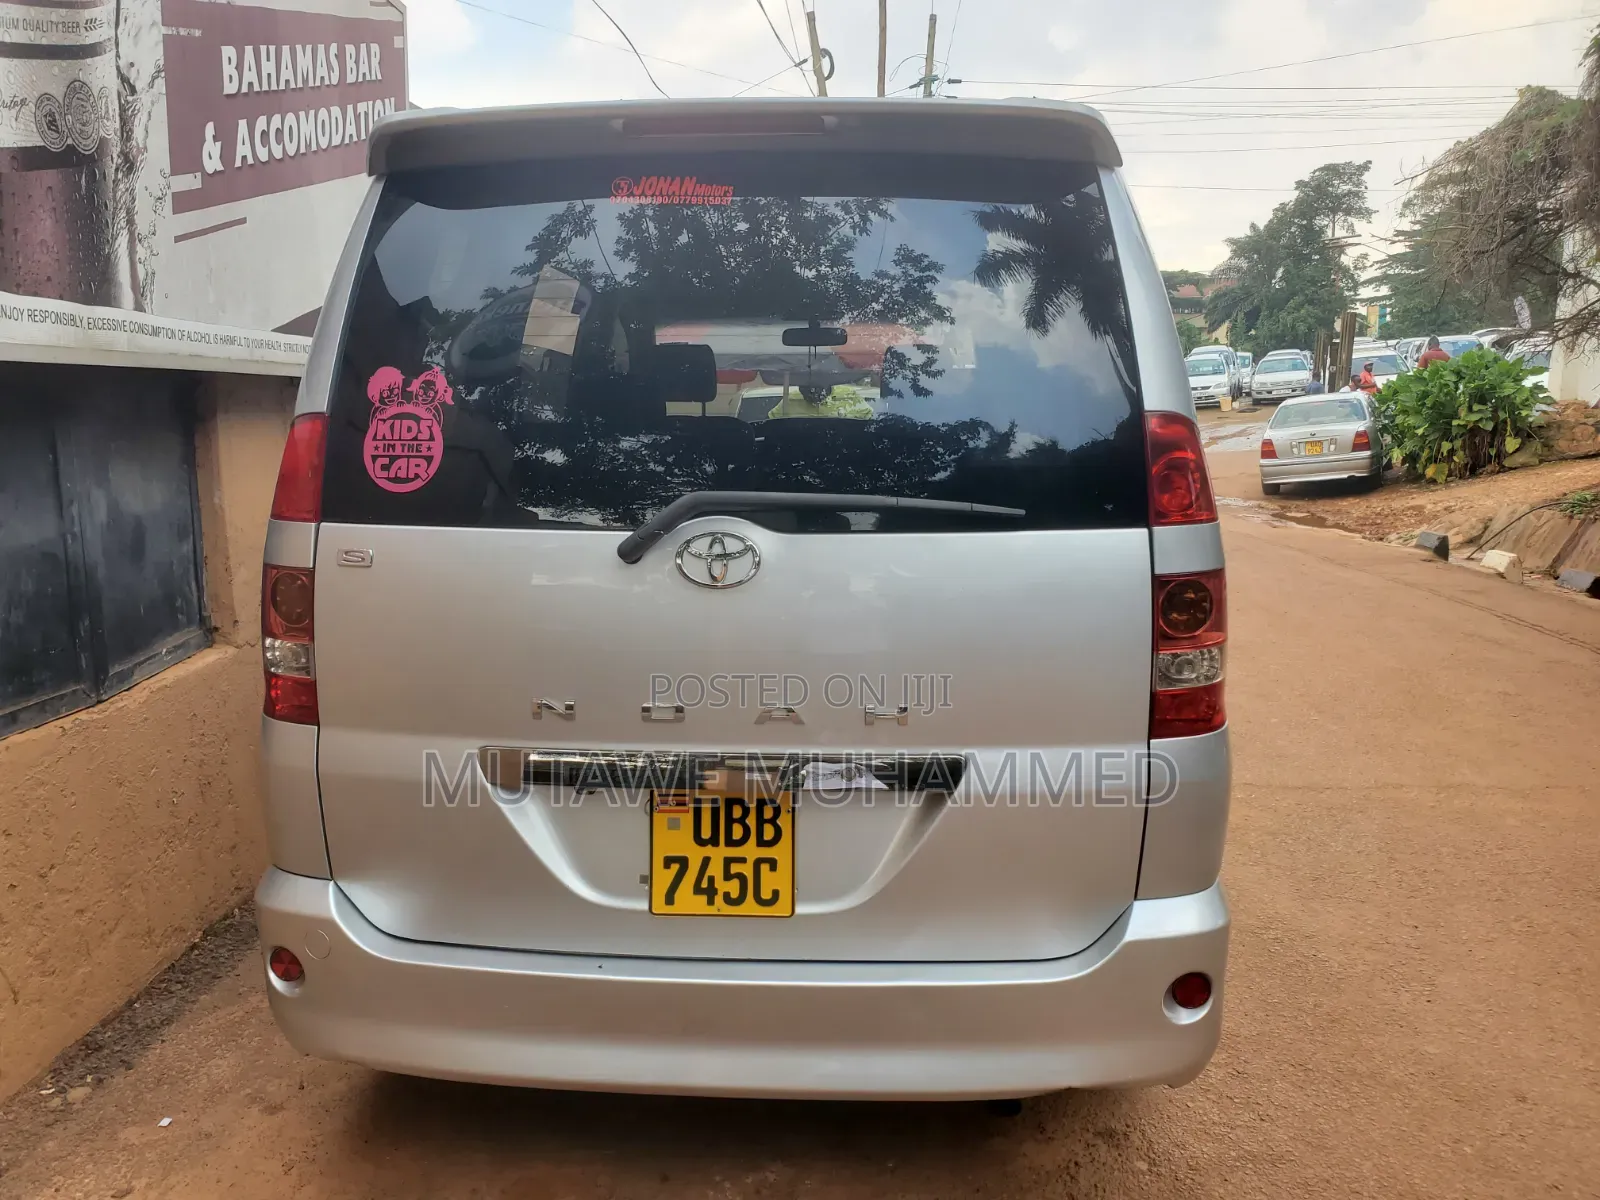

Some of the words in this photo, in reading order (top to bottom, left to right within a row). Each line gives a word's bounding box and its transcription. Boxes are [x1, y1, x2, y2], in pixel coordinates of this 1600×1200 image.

[22, 18, 59, 33] QUALITY
[62, 21, 80, 33] BEER
[220, 43, 340, 96] BAHAMAS
[345, 42, 382, 83] BAR
[201, 121, 224, 174] &
[633, 175, 697, 196] JONAN
[0, 304, 24, 322] NJOY
[27, 308, 86, 330] RESPONSIBLY,
[87, 317, 127, 333] EXCESSIVE
[129, 320, 176, 340] CONSUMPTION
[177, 329, 186, 341] OF
[187, 330, 212, 345] ALCOHOL
[213, 333, 219, 345] IS
[219, 334, 243, 347] HARMFUL
[243, 336, 250, 349] TO
[250, 338, 264, 349] YOUR
[376, 419, 433, 440] KIDS
[382, 443, 396, 453] IN
[400, 443, 423, 453] THE
[373, 457, 429, 482] CAR
[532, 697, 909, 726] NOAH
[692, 797, 783, 848] UBB
[663, 855, 780, 907] 745C
